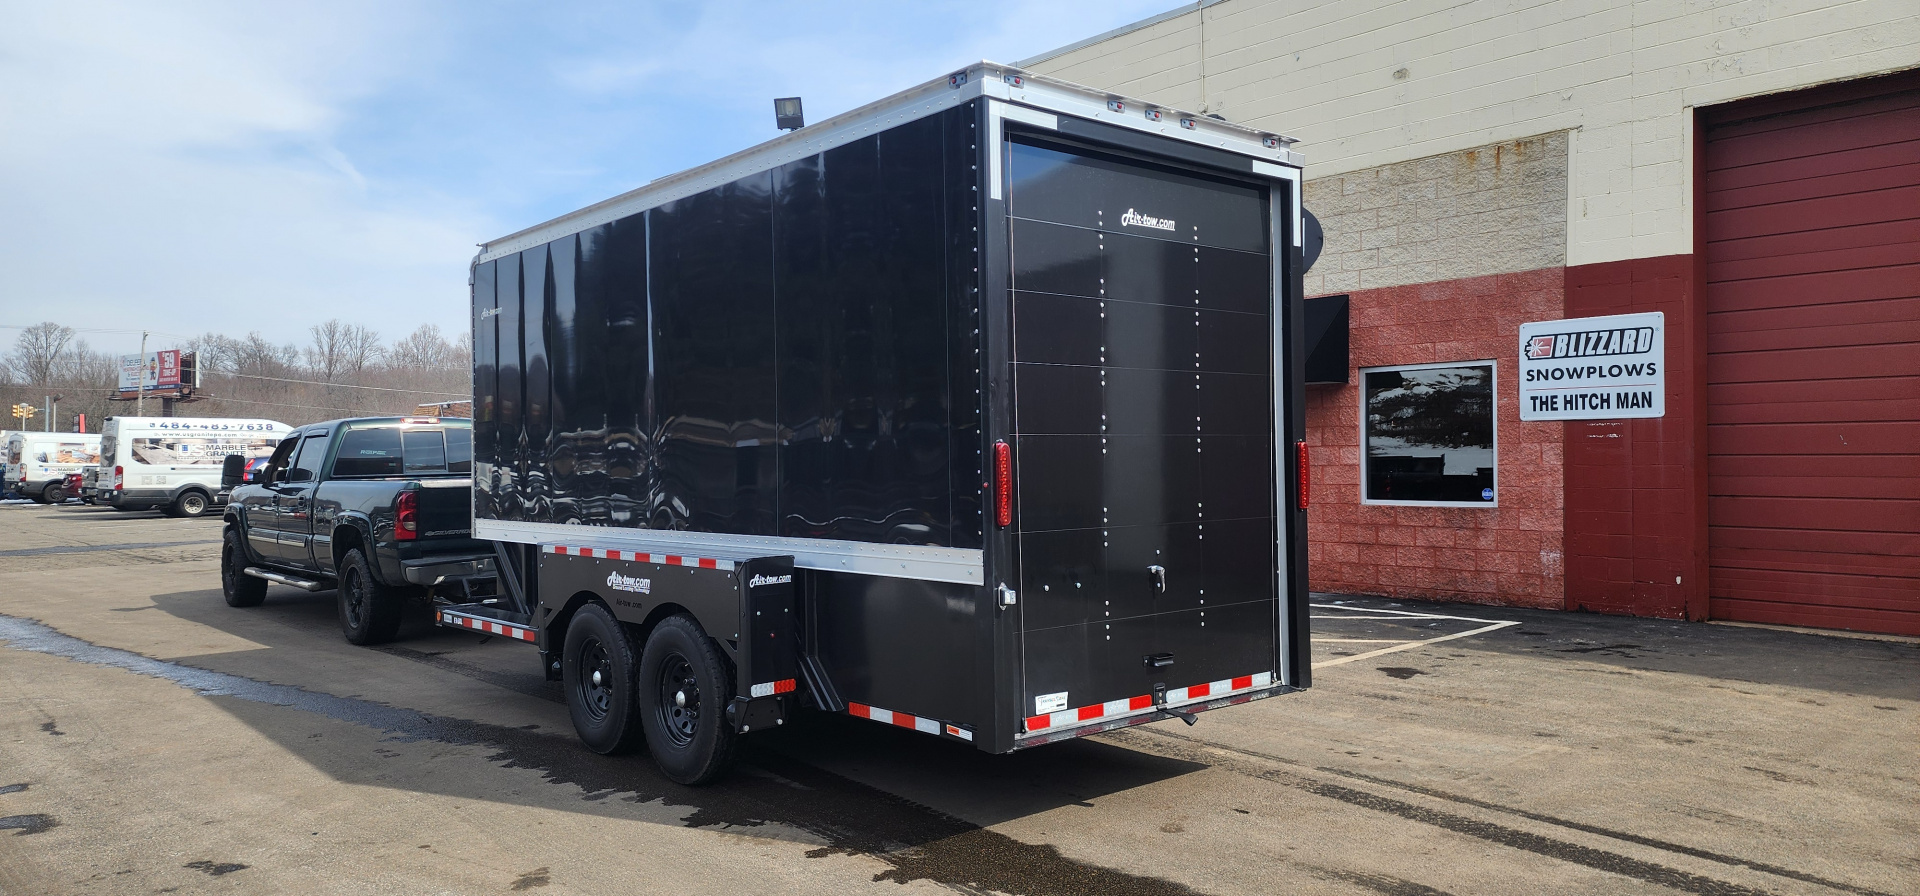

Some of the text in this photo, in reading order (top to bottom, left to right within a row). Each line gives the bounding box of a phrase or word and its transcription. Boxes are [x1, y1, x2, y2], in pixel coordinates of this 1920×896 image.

[1121, 208, 1175, 231] Air-tow.com
[1553, 328, 1653, 358] BLIZZARD
[1525, 362, 1657, 382] SNOWPLOWS
[1530, 391, 1653, 412] THE HITCH MAN
[607, 571, 651, 588] Air-tow.com
[749, 573, 792, 588] Air-tow.com
